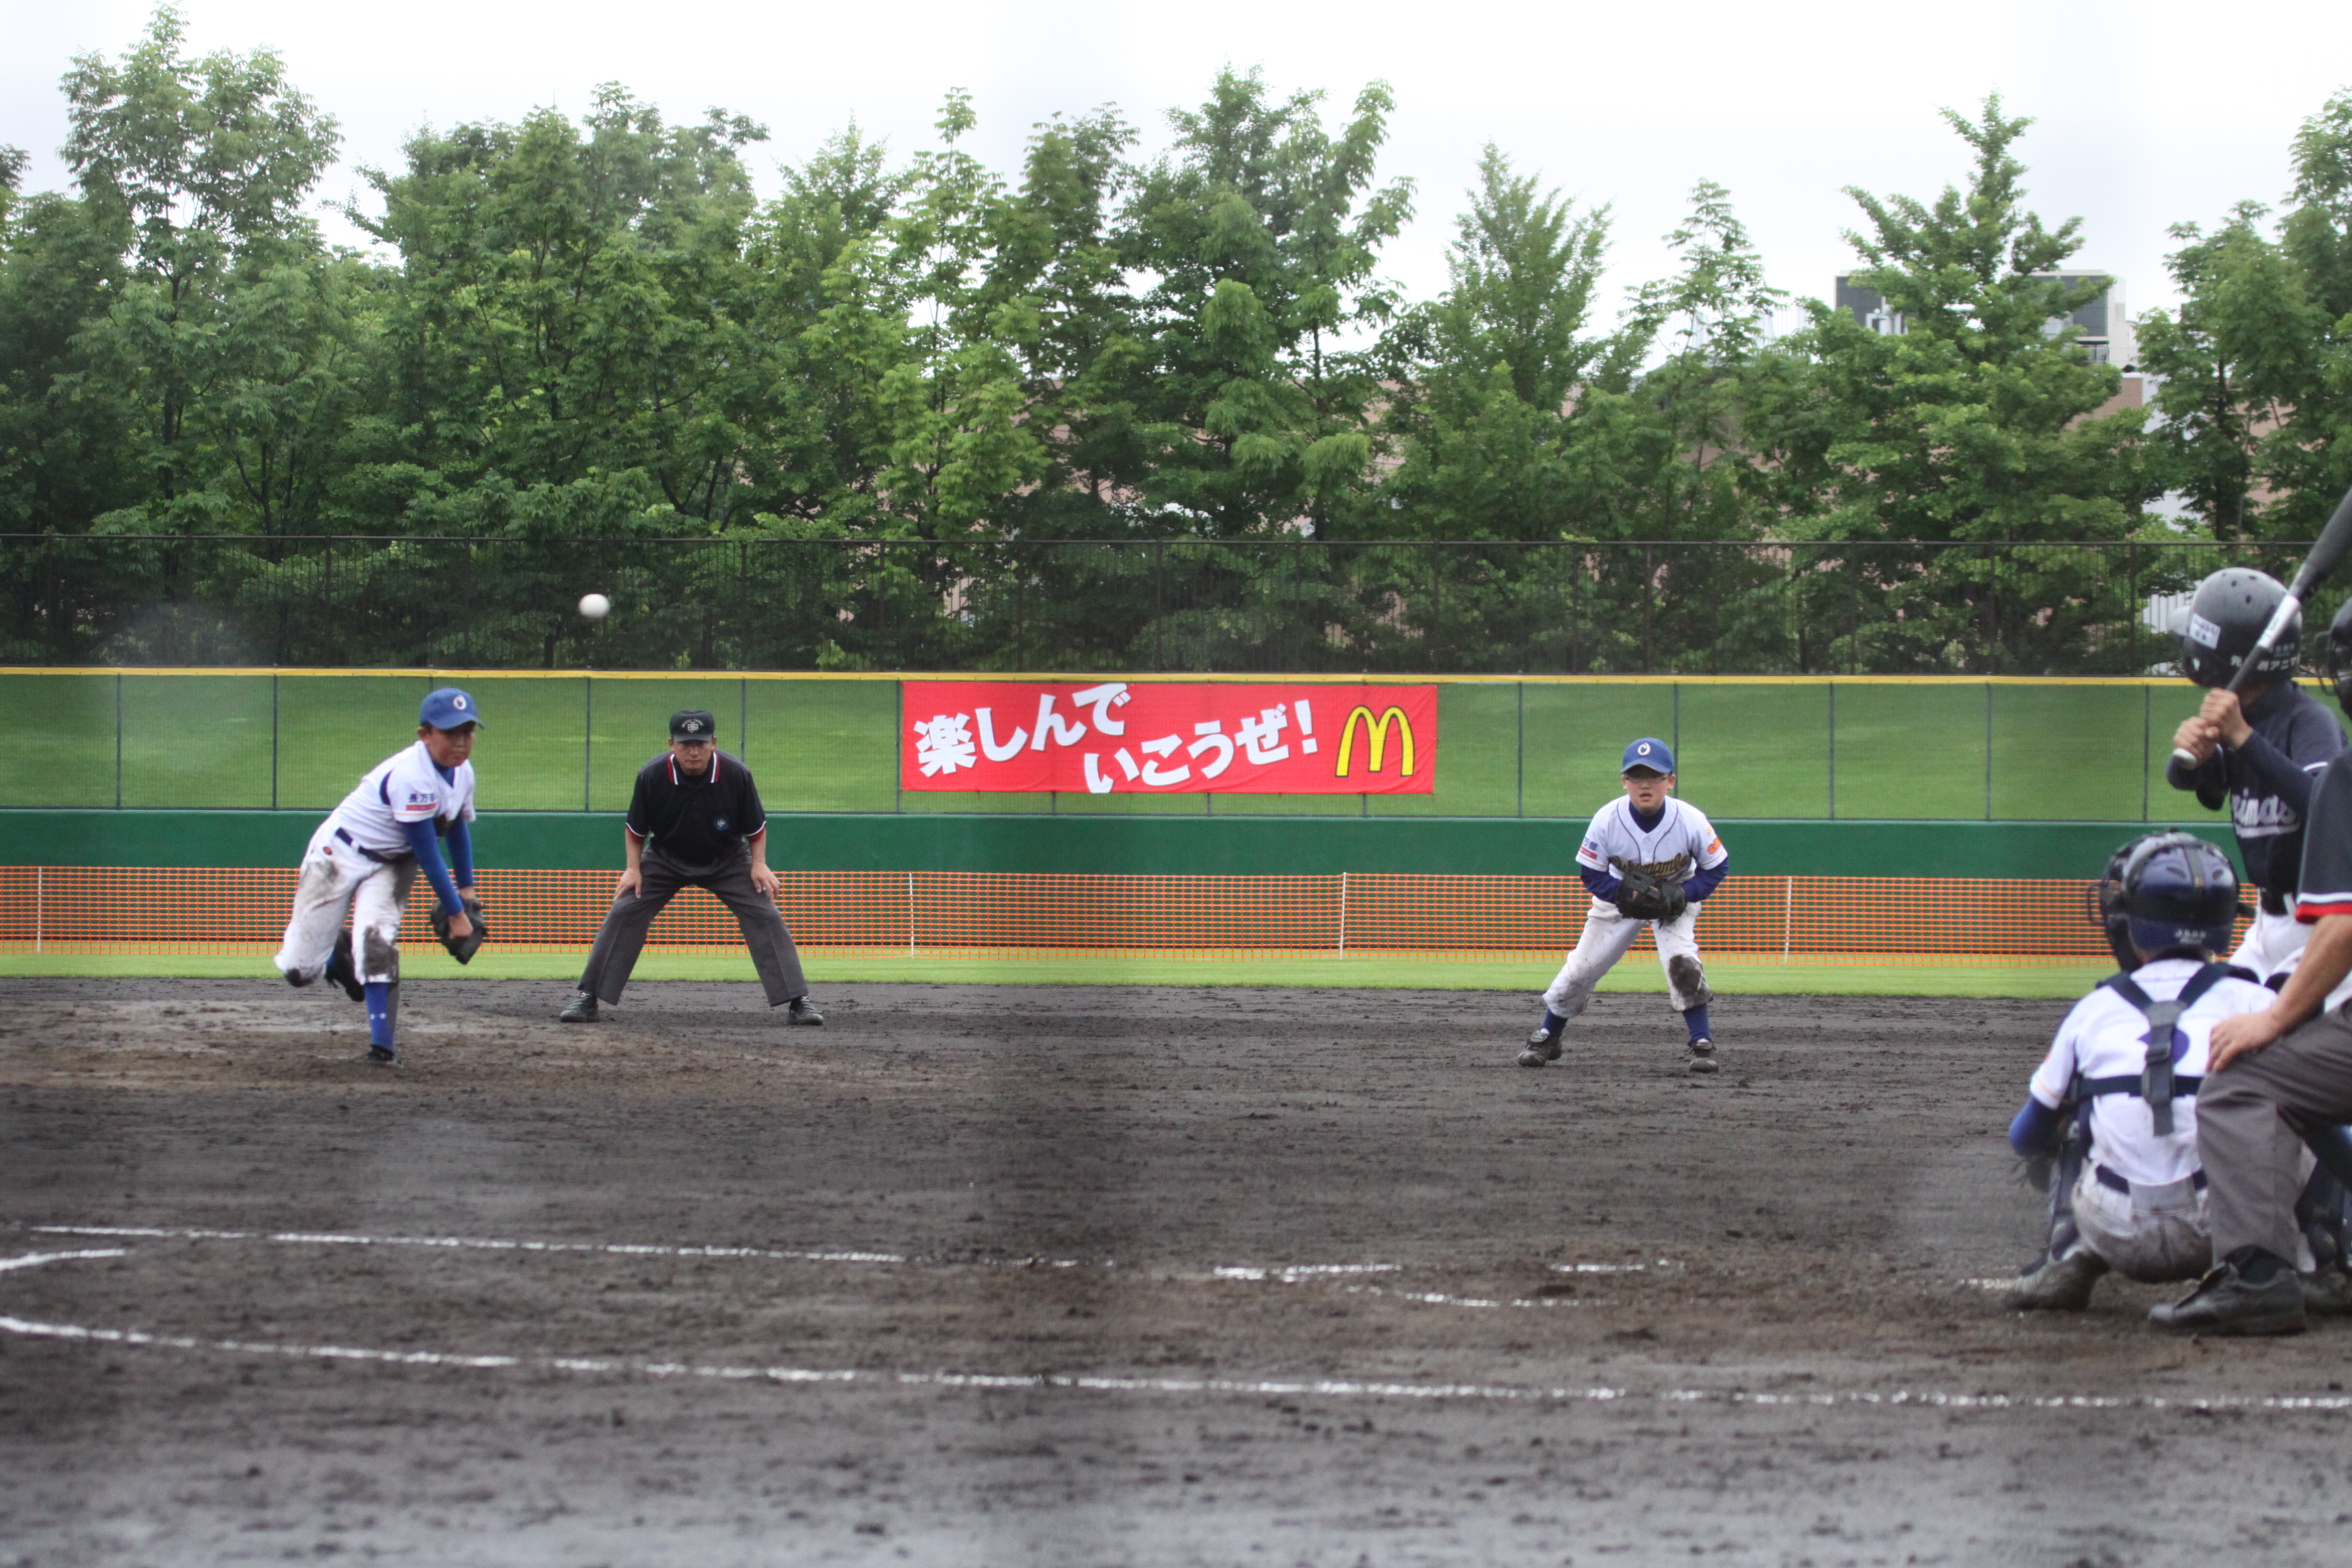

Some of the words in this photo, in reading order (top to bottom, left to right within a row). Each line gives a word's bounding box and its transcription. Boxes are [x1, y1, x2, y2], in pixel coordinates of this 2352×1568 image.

[914, 683, 1131, 777] 楽しんで
[1084, 699, 1319, 794] いこうぜ!
